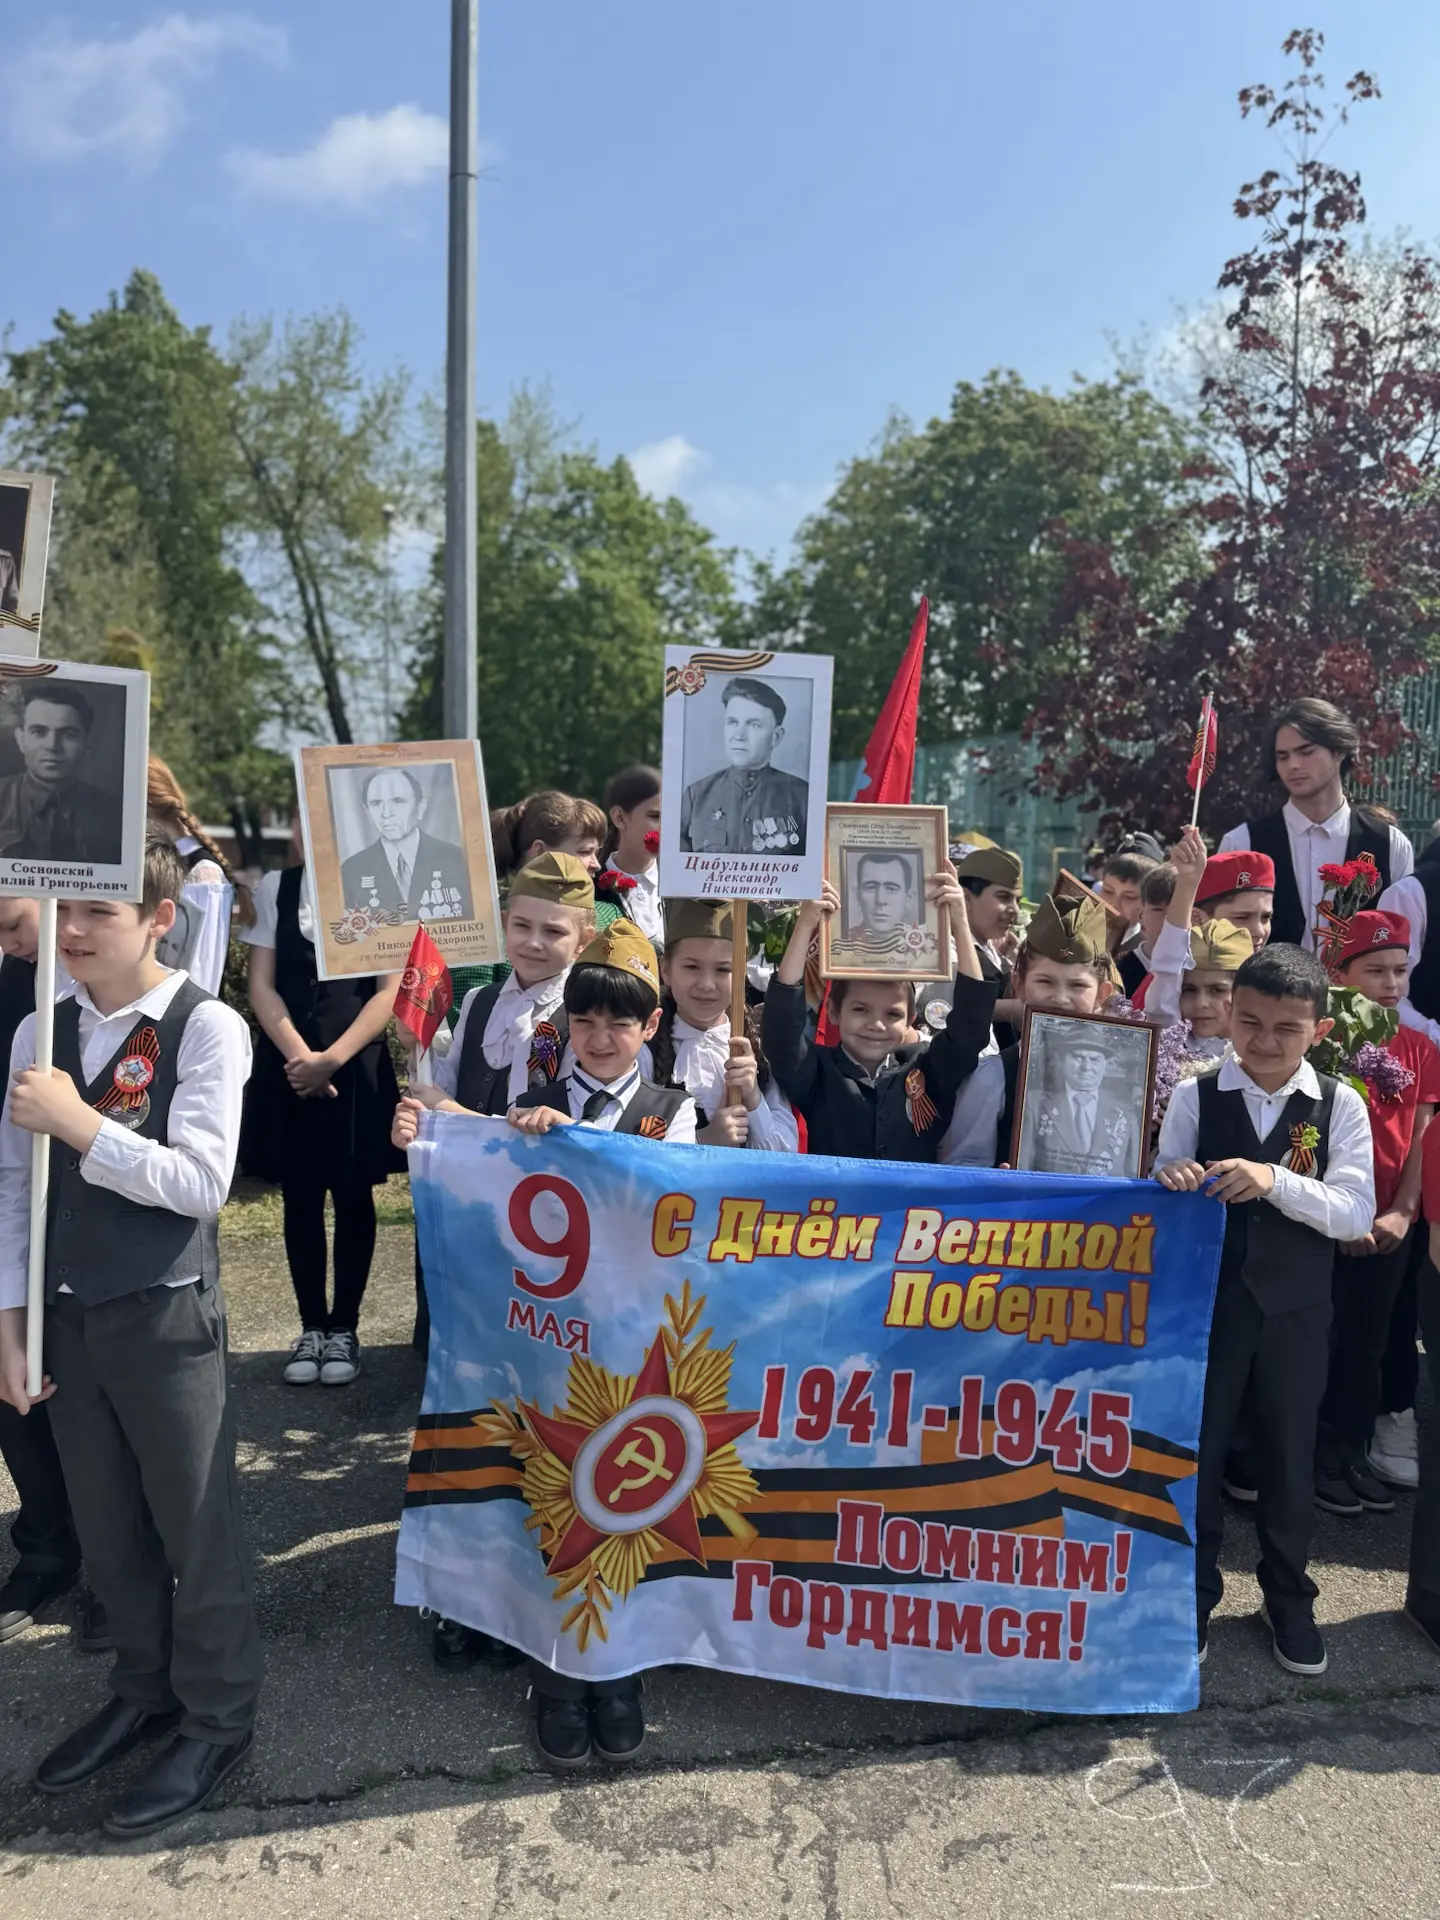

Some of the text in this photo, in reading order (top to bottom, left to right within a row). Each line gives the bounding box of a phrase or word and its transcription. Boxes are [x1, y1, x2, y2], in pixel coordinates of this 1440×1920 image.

[0, 876, 128, 891] илий Григорьевич
[11, 862, 94, 877] Сосновский
[685, 856, 799, 873] Цибульников
[701, 883, 782, 895] Никитович
[705, 872, 778, 886] Александр
[377, 940, 412, 951] Никол
[508, 1173, 591, 1300] 9
[652, 1192, 1156, 1275] С Днём Великой
[507, 1299, 591, 1354] МАЯ
[884, 1270, 1149, 1348] Победы!
[757, 1366, 1132, 1475] 1941-1945
[835, 1500, 1132, 1592] Помним!
[732, 1562, 1088, 1662] Гордимся!
